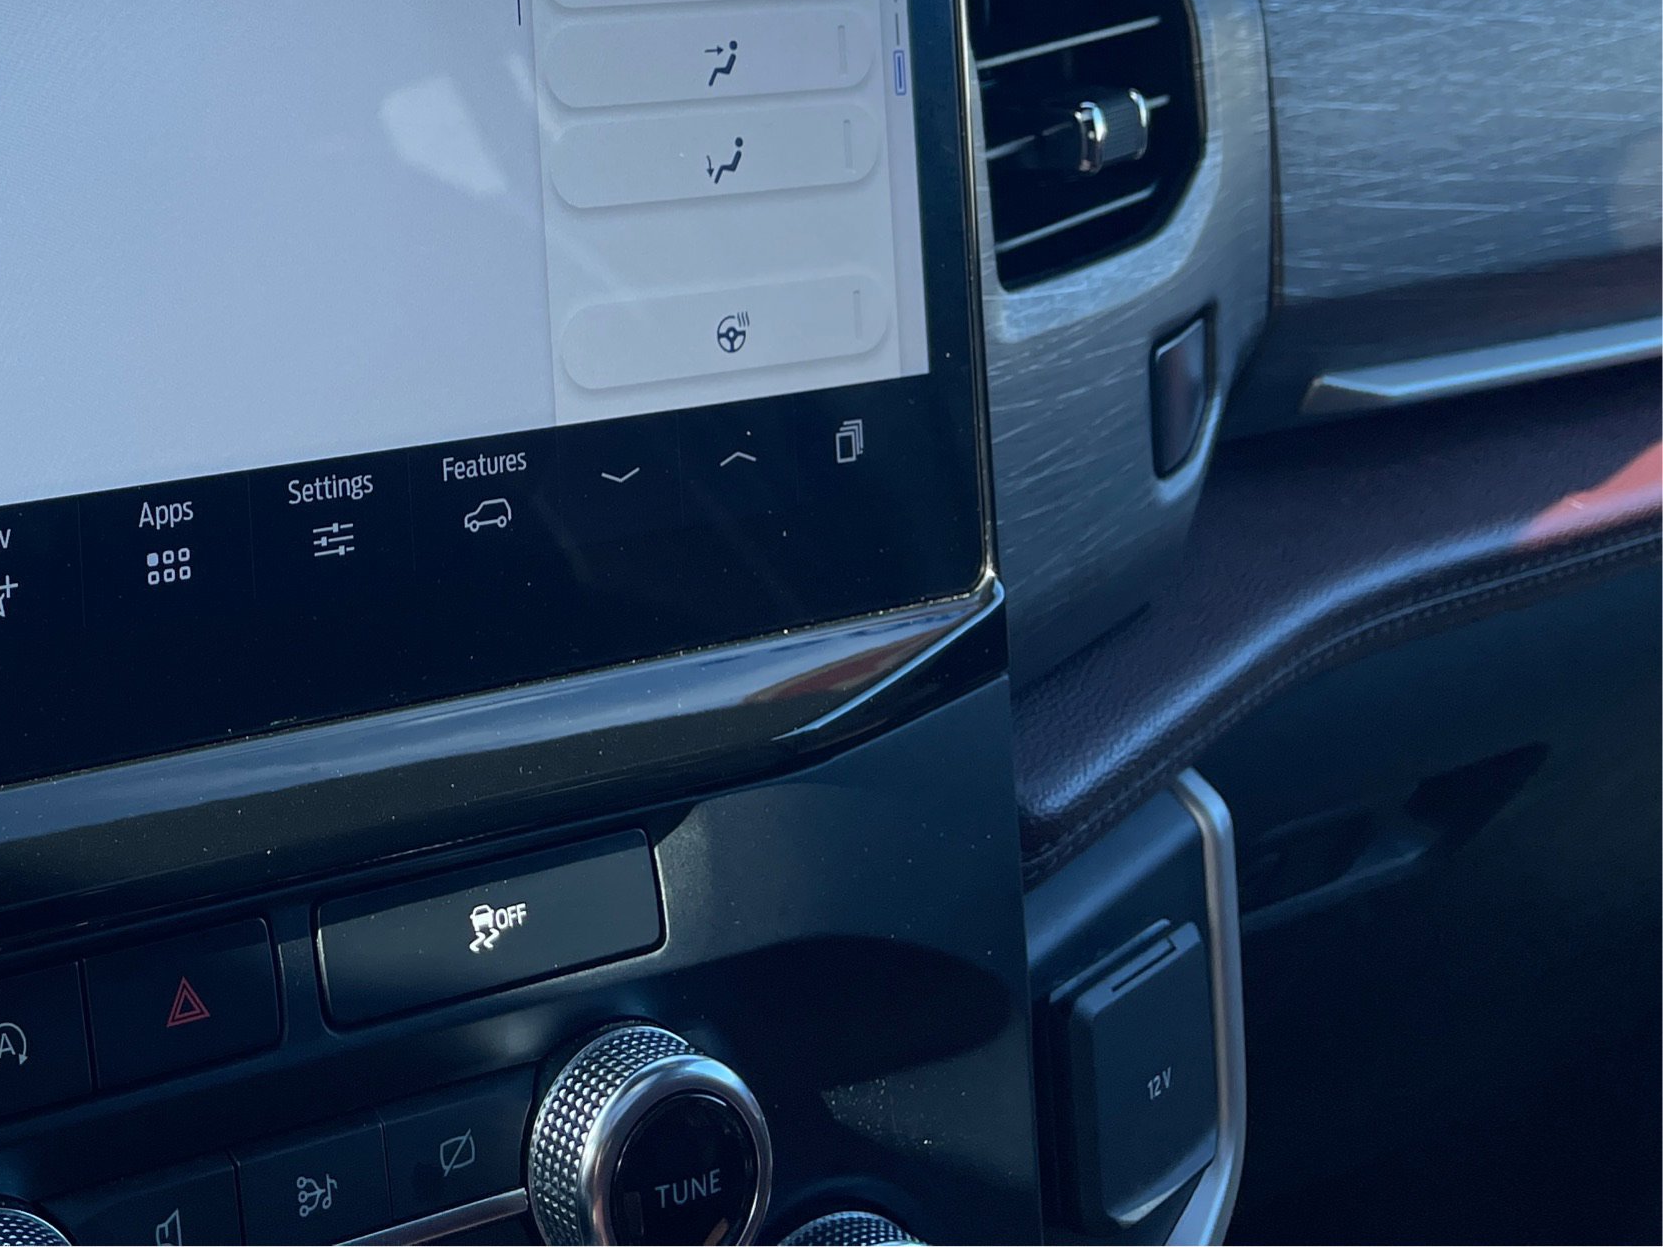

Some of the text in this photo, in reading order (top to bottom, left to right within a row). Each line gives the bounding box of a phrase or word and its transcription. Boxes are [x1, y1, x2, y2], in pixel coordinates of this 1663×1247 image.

[442, 449, 527, 482] Features
[288, 471, 374, 507] Settings
[138, 497, 194, 529] Apps
[495, 901, 528, 930] OFF
[654, 1168, 722, 1209] TUNE
